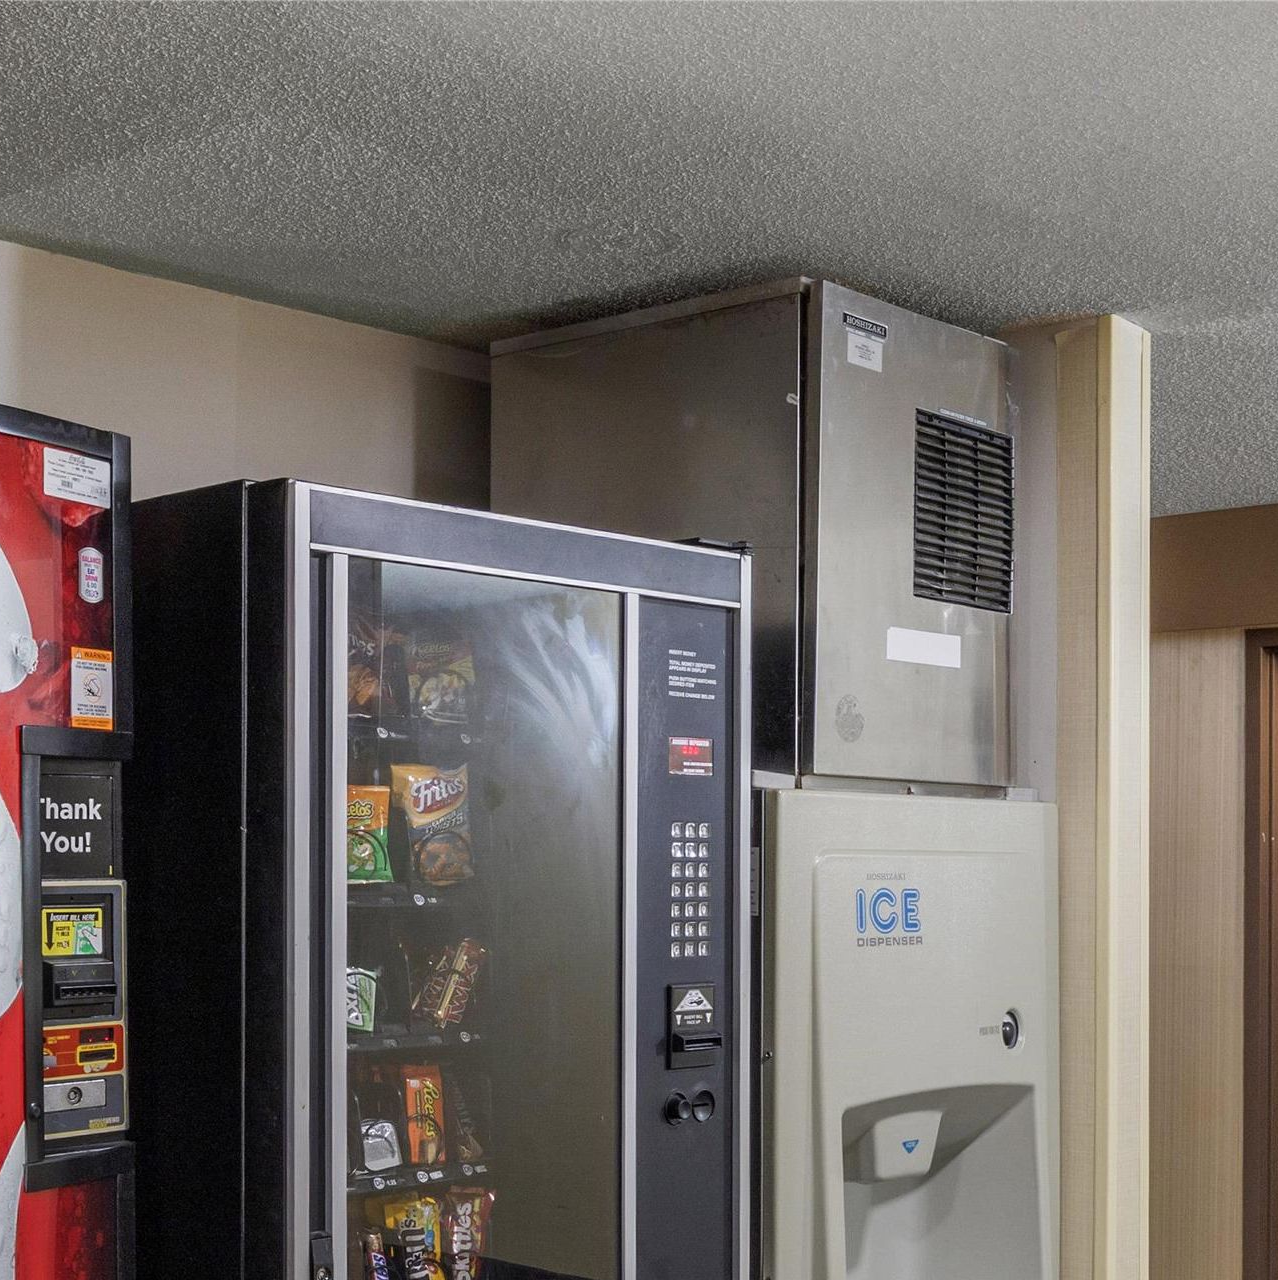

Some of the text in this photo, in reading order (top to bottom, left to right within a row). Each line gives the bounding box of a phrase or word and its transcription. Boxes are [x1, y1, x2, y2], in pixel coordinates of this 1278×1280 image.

[846, 315, 885, 336] HOSHIZAKI
[84, 651, 110, 661] WARNING
[410, 778, 464, 813] Fritos
[40, 832, 91, 853] You!
[855, 887, 921, 934] ICE
[856, 936, 923, 948] DISPENSER
